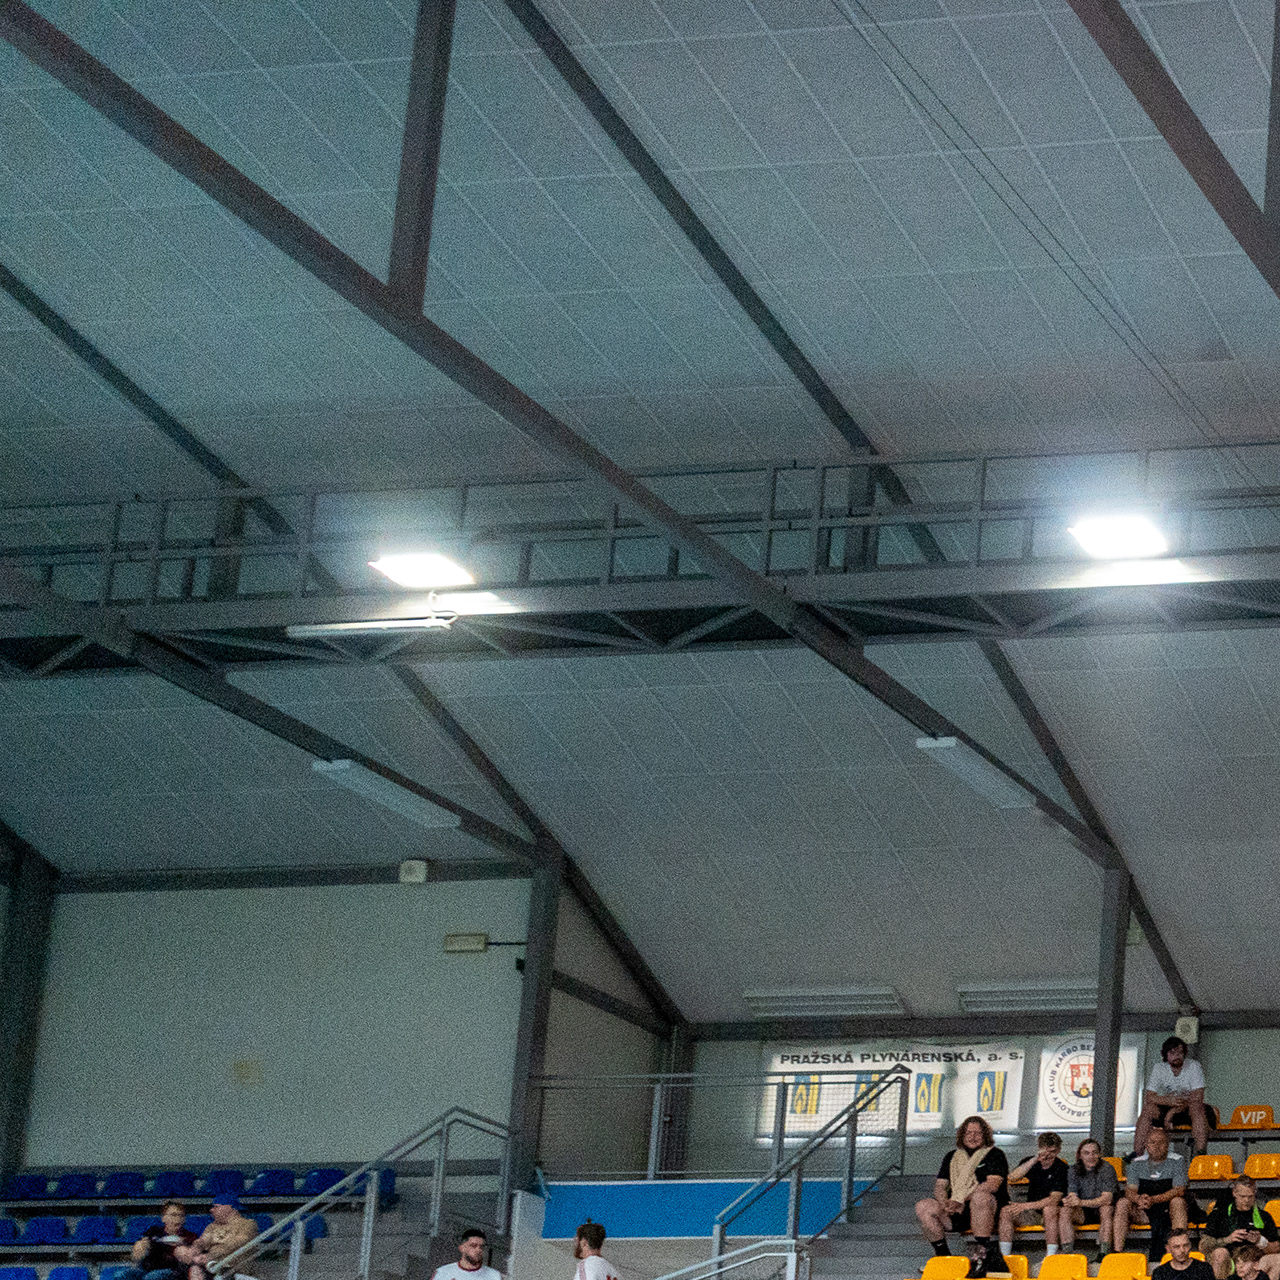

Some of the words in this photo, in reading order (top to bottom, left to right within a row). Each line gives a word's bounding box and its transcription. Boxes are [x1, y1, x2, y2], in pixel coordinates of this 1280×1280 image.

[780, 1051, 854, 1064] PRAŽSKÁ
[860, 1050, 981, 1063] PLYNÁRENSKÁ,
[987, 1054, 1002, 1062] a.
[1049, 1070, 1057, 1093] KLUB
[1240, 1110, 1267, 1124] VIP
